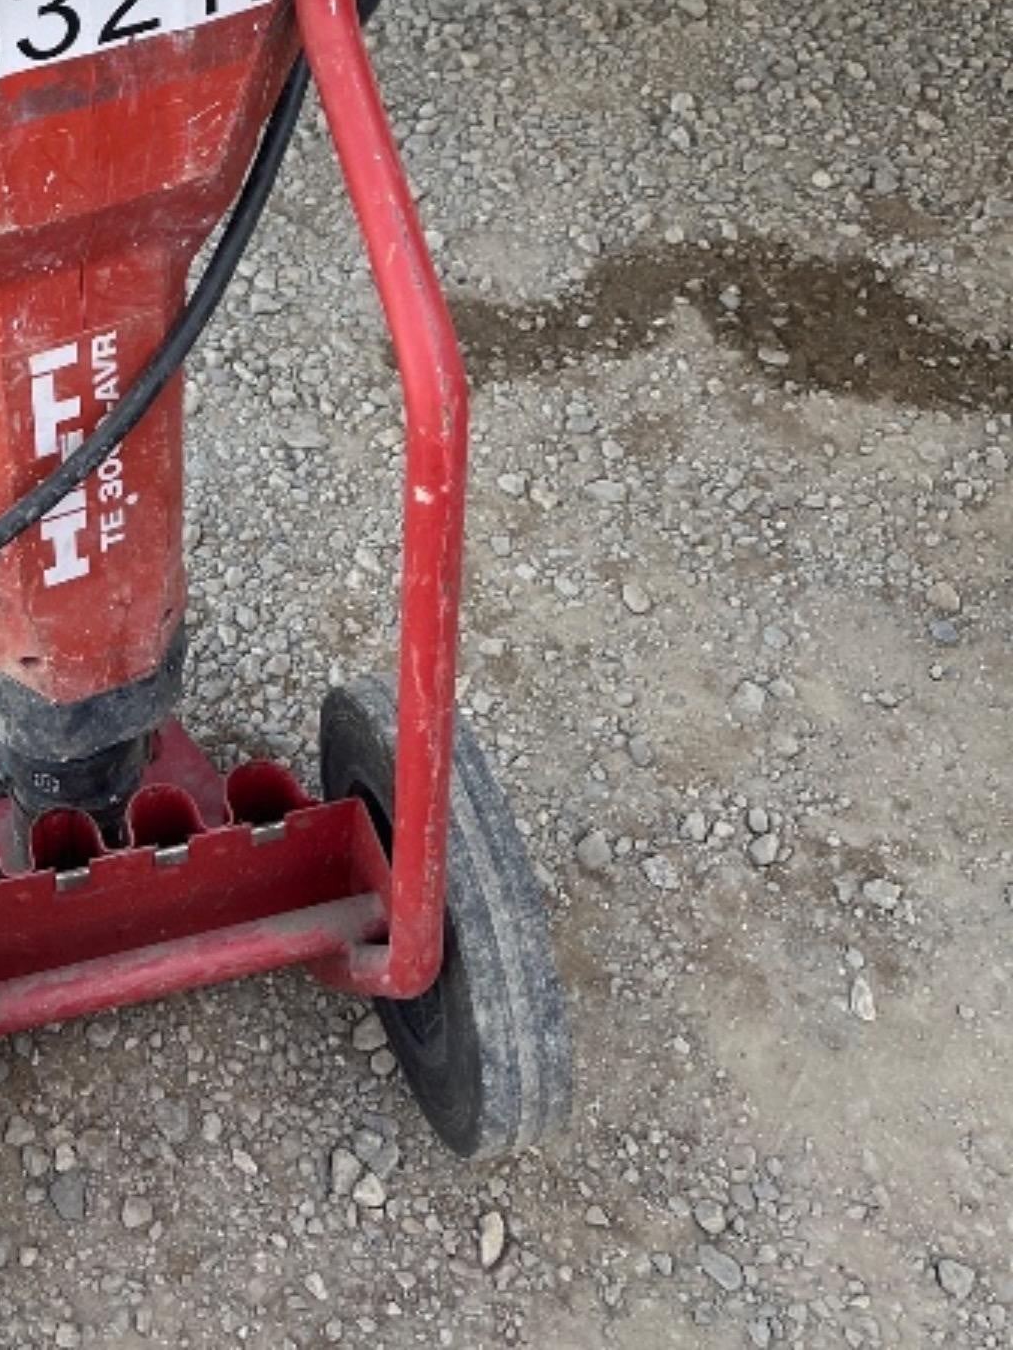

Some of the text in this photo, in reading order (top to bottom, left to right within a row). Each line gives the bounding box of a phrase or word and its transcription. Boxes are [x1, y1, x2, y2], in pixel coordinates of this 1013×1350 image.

[29, 342, 90, 588] HITI
[91, 330, 126, 553] TE 30-AVR
